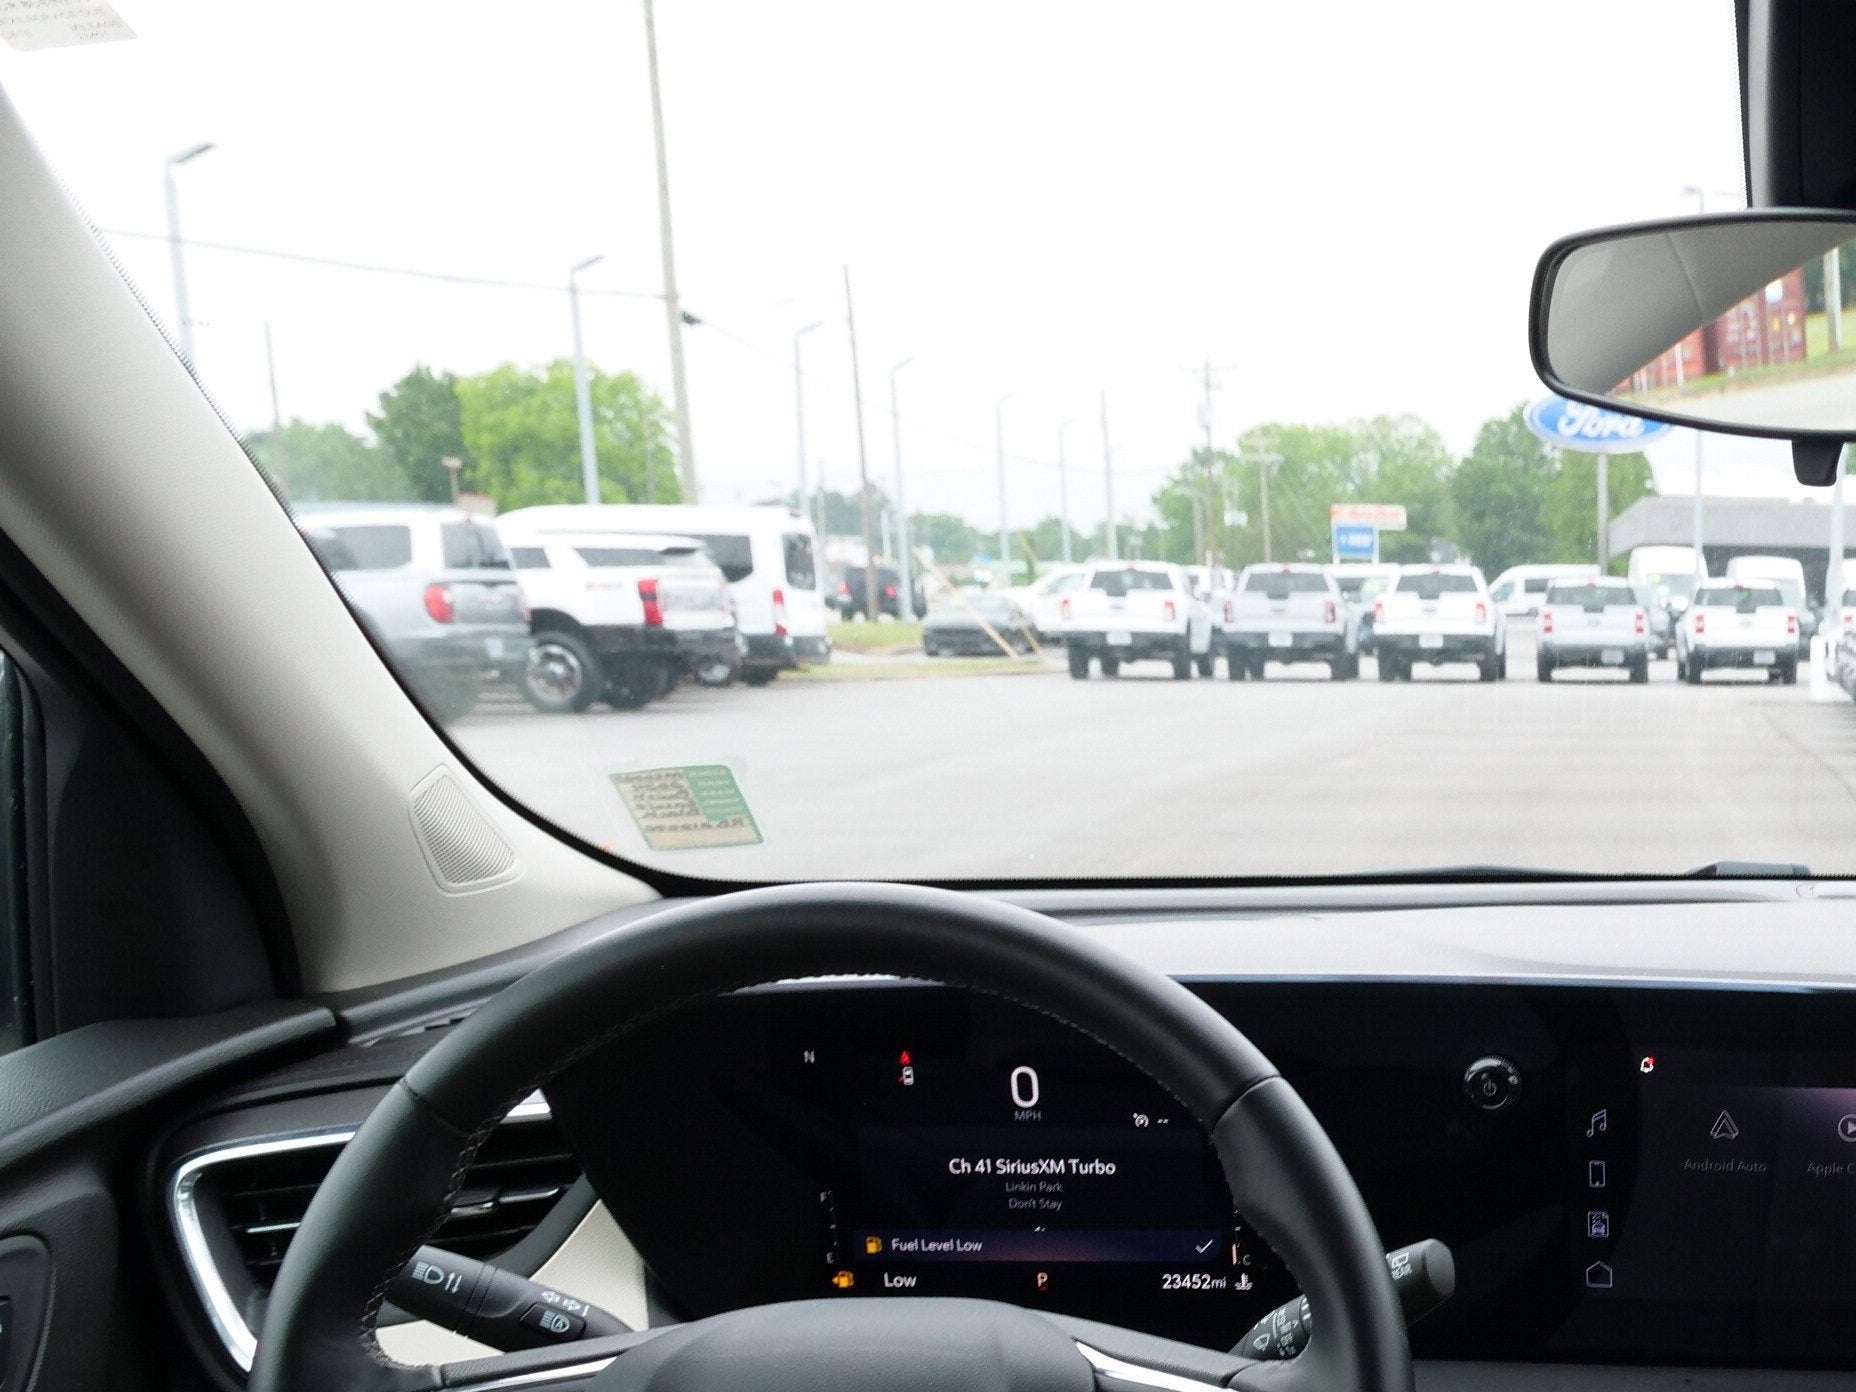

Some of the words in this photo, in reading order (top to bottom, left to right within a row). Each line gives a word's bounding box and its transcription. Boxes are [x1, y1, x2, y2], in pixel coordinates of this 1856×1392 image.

[1557, 400, 1645, 438] Ford
[803, 1050, 815, 1064] N
[1010, 1065, 1040, 1109] 0
[1014, 1110, 1042, 1121] MPH
[948, 1157, 972, 1175] Ch
[975, 1158, 992, 1175] 41
[995, 1157, 1066, 1175] SiriusXM
[1067, 1157, 1117, 1175] Turbo
[1684, 1157, 1735, 1173] Android
[1737, 1159, 1768, 1173] Auto
[1806, 1161, 1843, 1177] Apple
[1005, 1180, 1037, 1193] Linkin
[1039, 1180, 1063, 1193] Park
[1008, 1197, 1037, 1210] Don't
[1039, 1197, 1063, 1212] Stay
[891, 1237, 919, 1252] Fuel
[920, 1238, 954, 1252] Level
[956, 1238, 984, 1252] Low
[883, 1271, 918, 1288] Low
[1036, 1271, 1049, 1288] P
